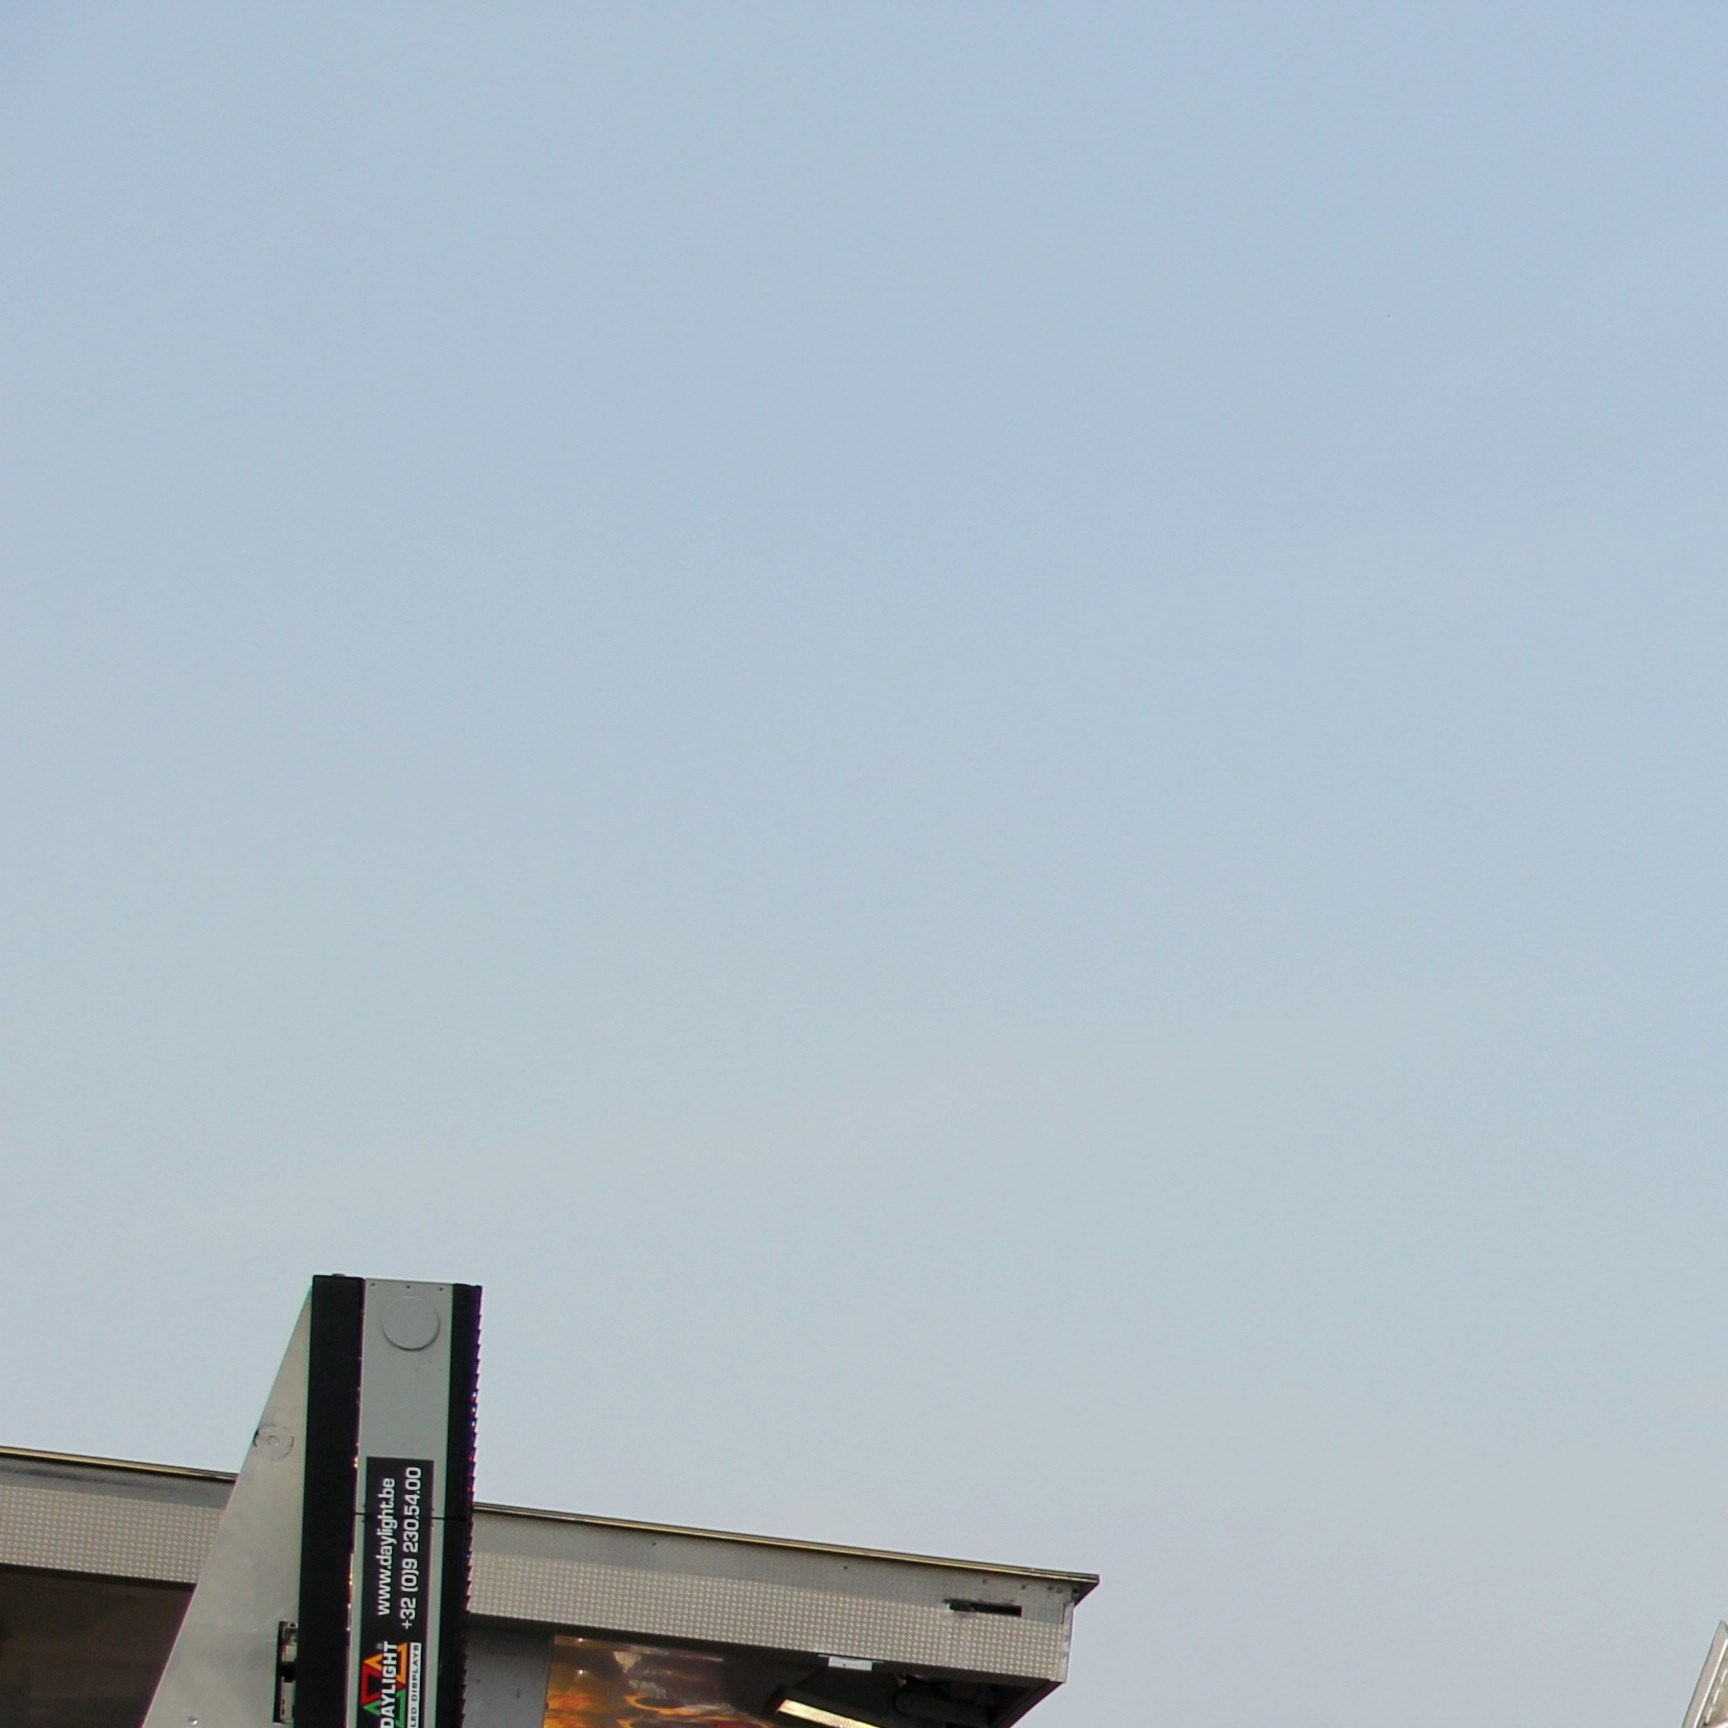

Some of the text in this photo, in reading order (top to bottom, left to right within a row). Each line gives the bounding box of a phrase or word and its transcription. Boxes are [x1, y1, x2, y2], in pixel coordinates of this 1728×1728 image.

[376, 1477, 398, 1616] www.daylight.be
[400, 1466, 422, 1630] +32 (0)9 230.54.00
[410, 1645, 420, 1728] LED DISPLAYS
